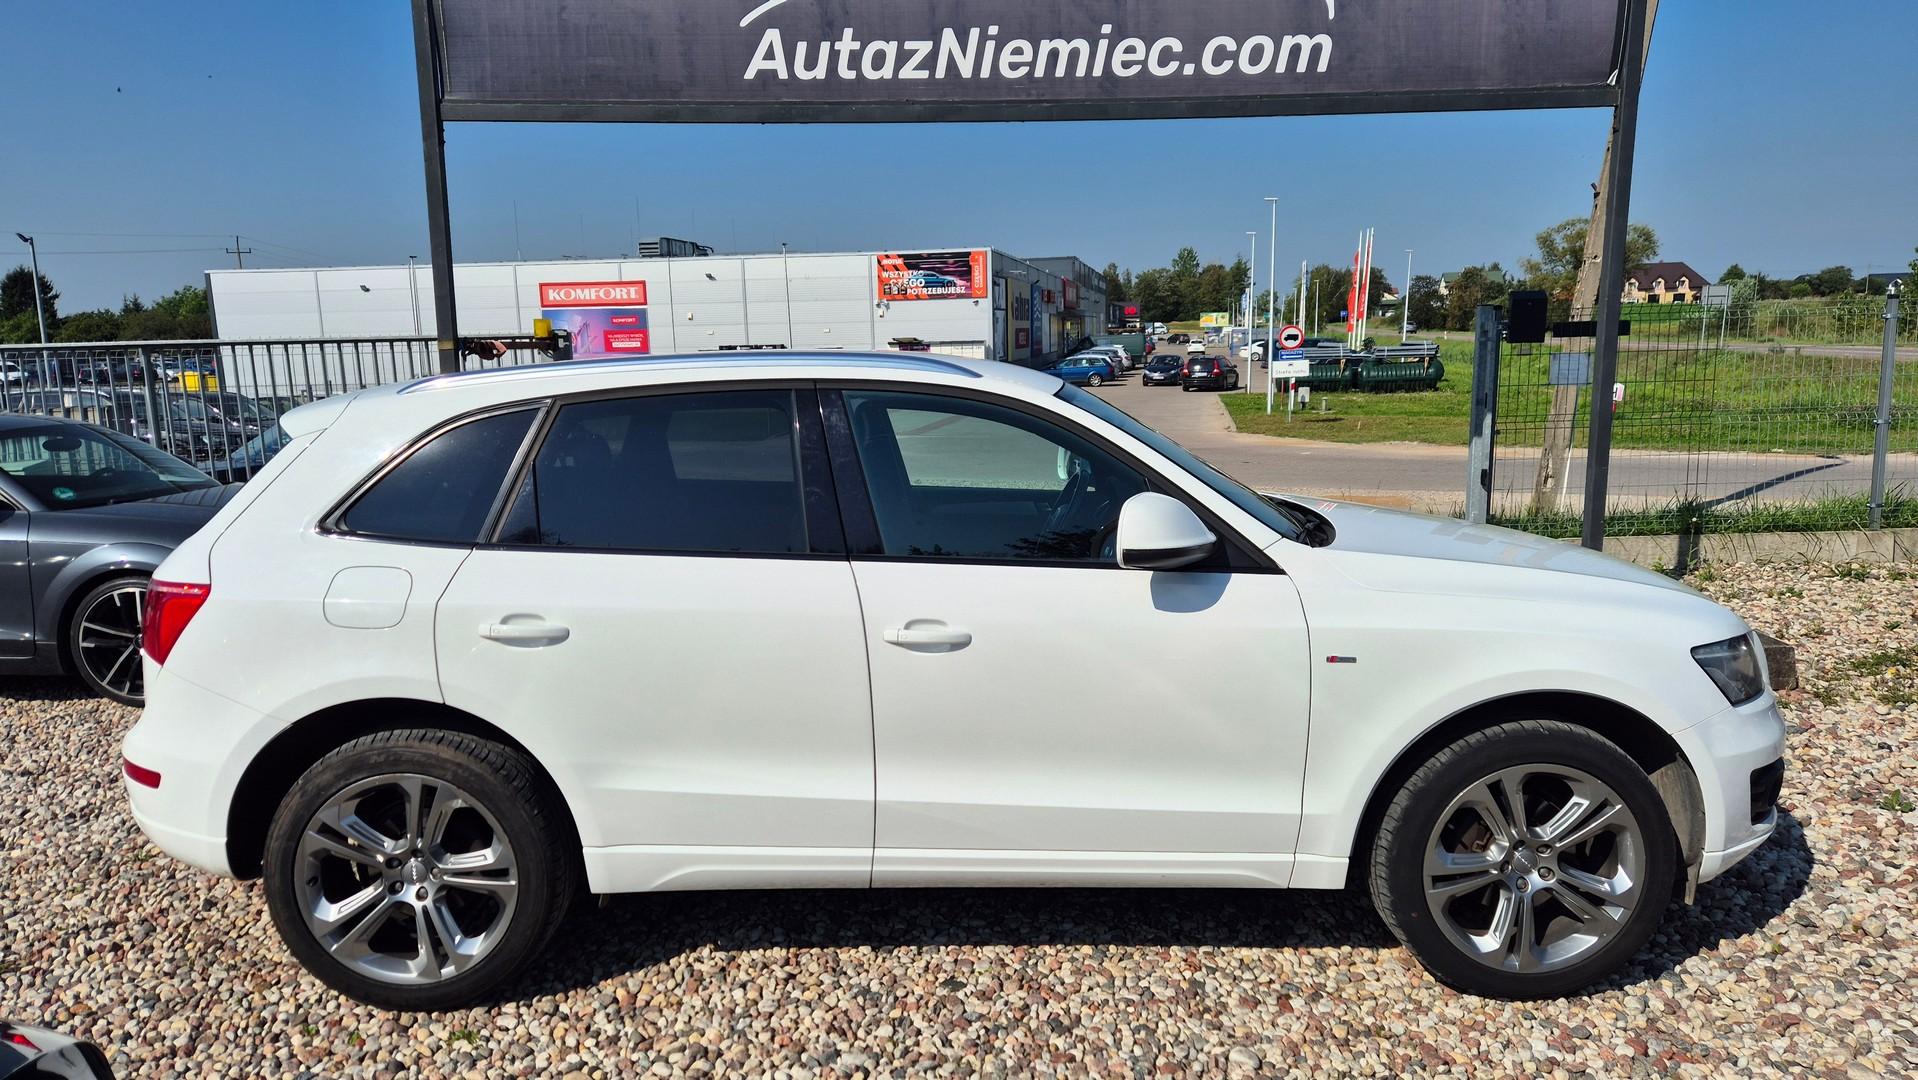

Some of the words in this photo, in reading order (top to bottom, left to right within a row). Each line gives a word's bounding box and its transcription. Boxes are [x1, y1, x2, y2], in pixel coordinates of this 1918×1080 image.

[744, 23, 1334, 81] AutazNiemiec.com
[881, 270, 925, 278] WSZYSTKO
[548, 286, 639, 301] KOMFORT
[907, 286, 966, 296] POTRZEBUJESZ
